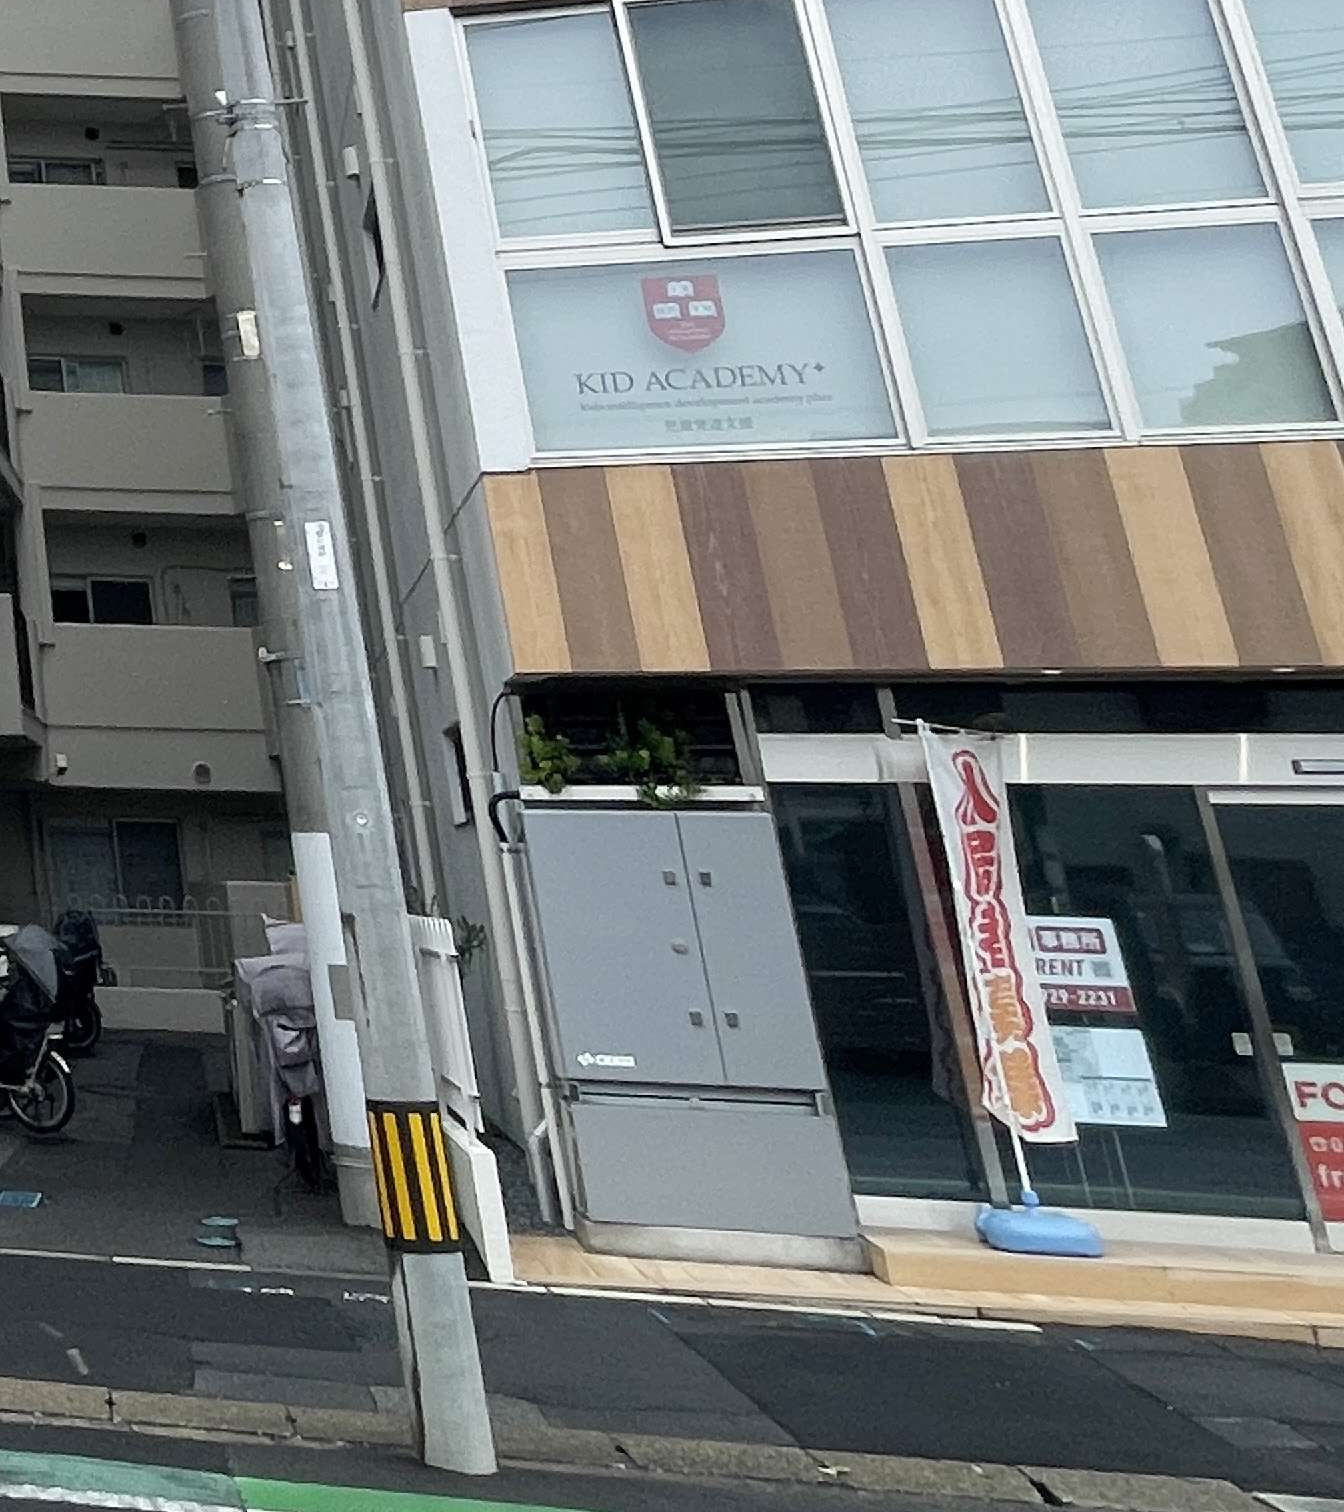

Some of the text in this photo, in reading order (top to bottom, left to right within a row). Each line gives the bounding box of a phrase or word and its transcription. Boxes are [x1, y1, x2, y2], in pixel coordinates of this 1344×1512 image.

[573, 363, 809, 394] KID ACADEMY
[1035, 957, 1084, 977] RENT
